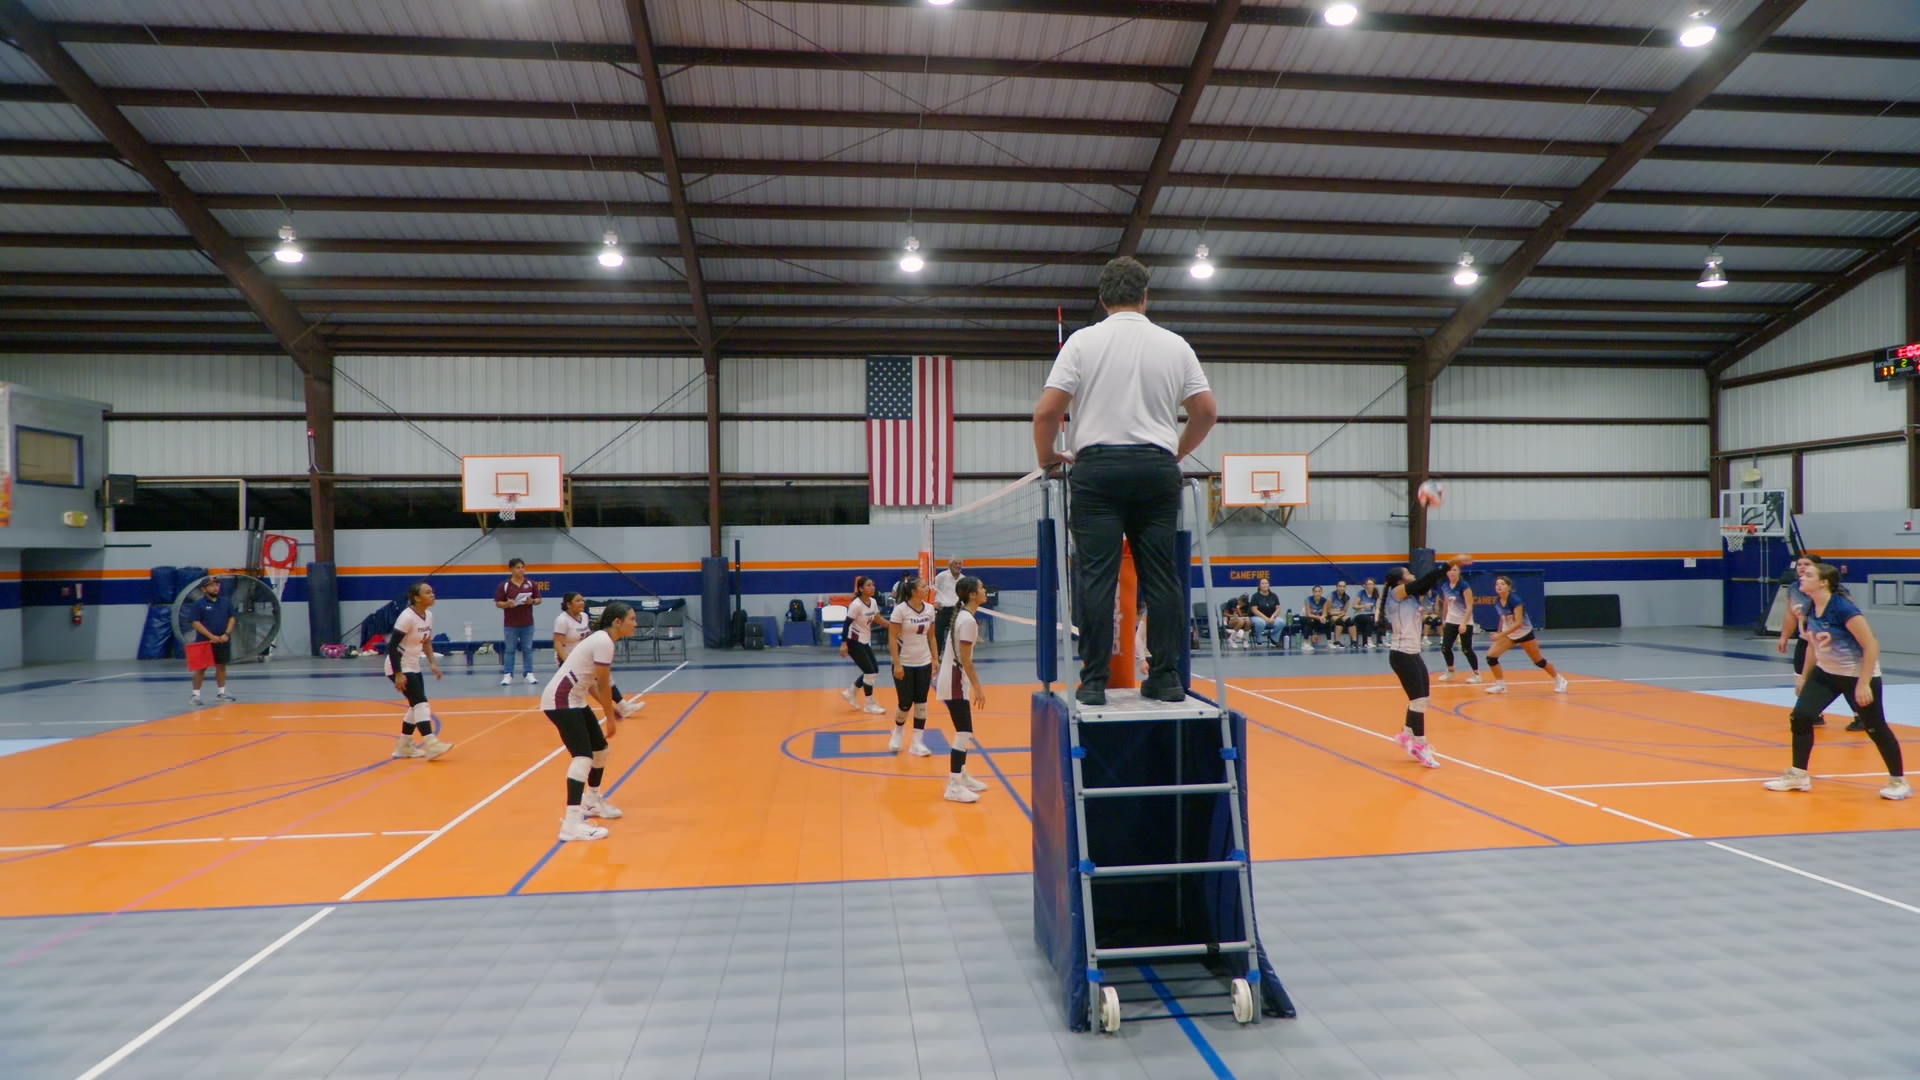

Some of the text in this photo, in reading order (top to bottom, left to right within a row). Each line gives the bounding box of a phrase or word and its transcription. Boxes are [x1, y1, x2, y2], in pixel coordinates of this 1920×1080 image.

[1901, 358, 1908, 368] 2
[1882, 365, 1894, 376] 11
[1230, 570, 1270, 580] CANEFIRE
[1473, 596, 1497, 604] CANEF
